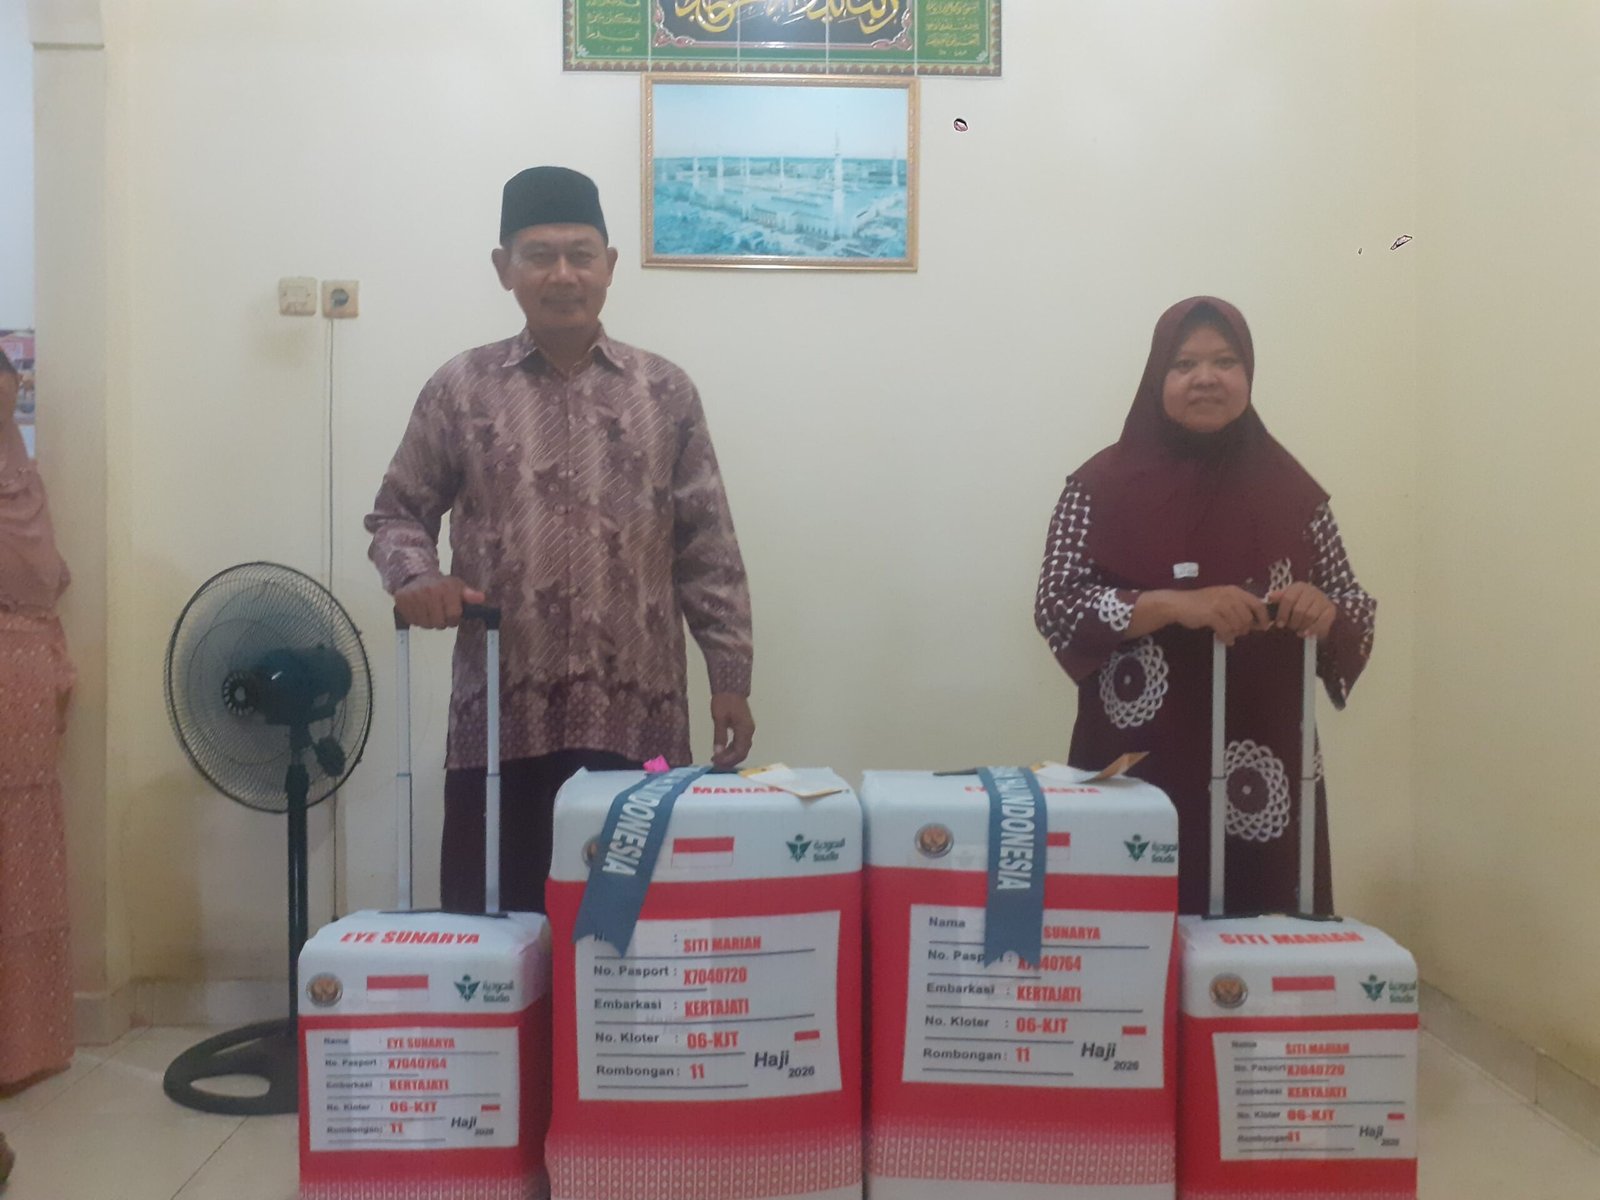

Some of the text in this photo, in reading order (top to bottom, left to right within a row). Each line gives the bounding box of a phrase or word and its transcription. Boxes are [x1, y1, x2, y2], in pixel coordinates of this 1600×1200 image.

[929, 917, 1101, 940] Nama SUNARYA
[340, 930, 480, 945] EYE SUNARYA
[683, 939, 708, 953] SITI
[712, 936, 762, 951] MARIAH
[1219, 932, 1364, 945] SITI MARIAH
[928, 950, 949, 961] No.
[594, 965, 615, 977] No.
[619, 965, 669, 978] Pasport
[683, 967, 747, 985] X7040720
[926, 983, 995, 995] Embarkasi
[1017, 986, 1082, 1003] KERTAJATI
[594, 999, 662, 1010] Embarkasi
[685, 998, 749, 1017] KERTAJATI
[925, 1016, 946, 1027] No.
[951, 1016, 990, 1028] Kloter
[1016, 1017, 1069, 1034] 06-KJT
[387, 1037, 404, 1049] EYE
[595, 1032, 617, 1044] No.
[620, 1032, 659, 1044] Kloter
[687, 1031, 739, 1049] 06-KJT
[1016, 1047, 1030, 1062] 11
[1081, 1042, 1139, 1071] Haji 2026
[690, 1064, 705, 1080] 11
[754, 1050, 815, 1078] Haji 2026
[390, 1122, 404, 1134] 11
[451, 1117, 477, 1130] Haji
[1359, 1125, 1384, 1140] Haji
